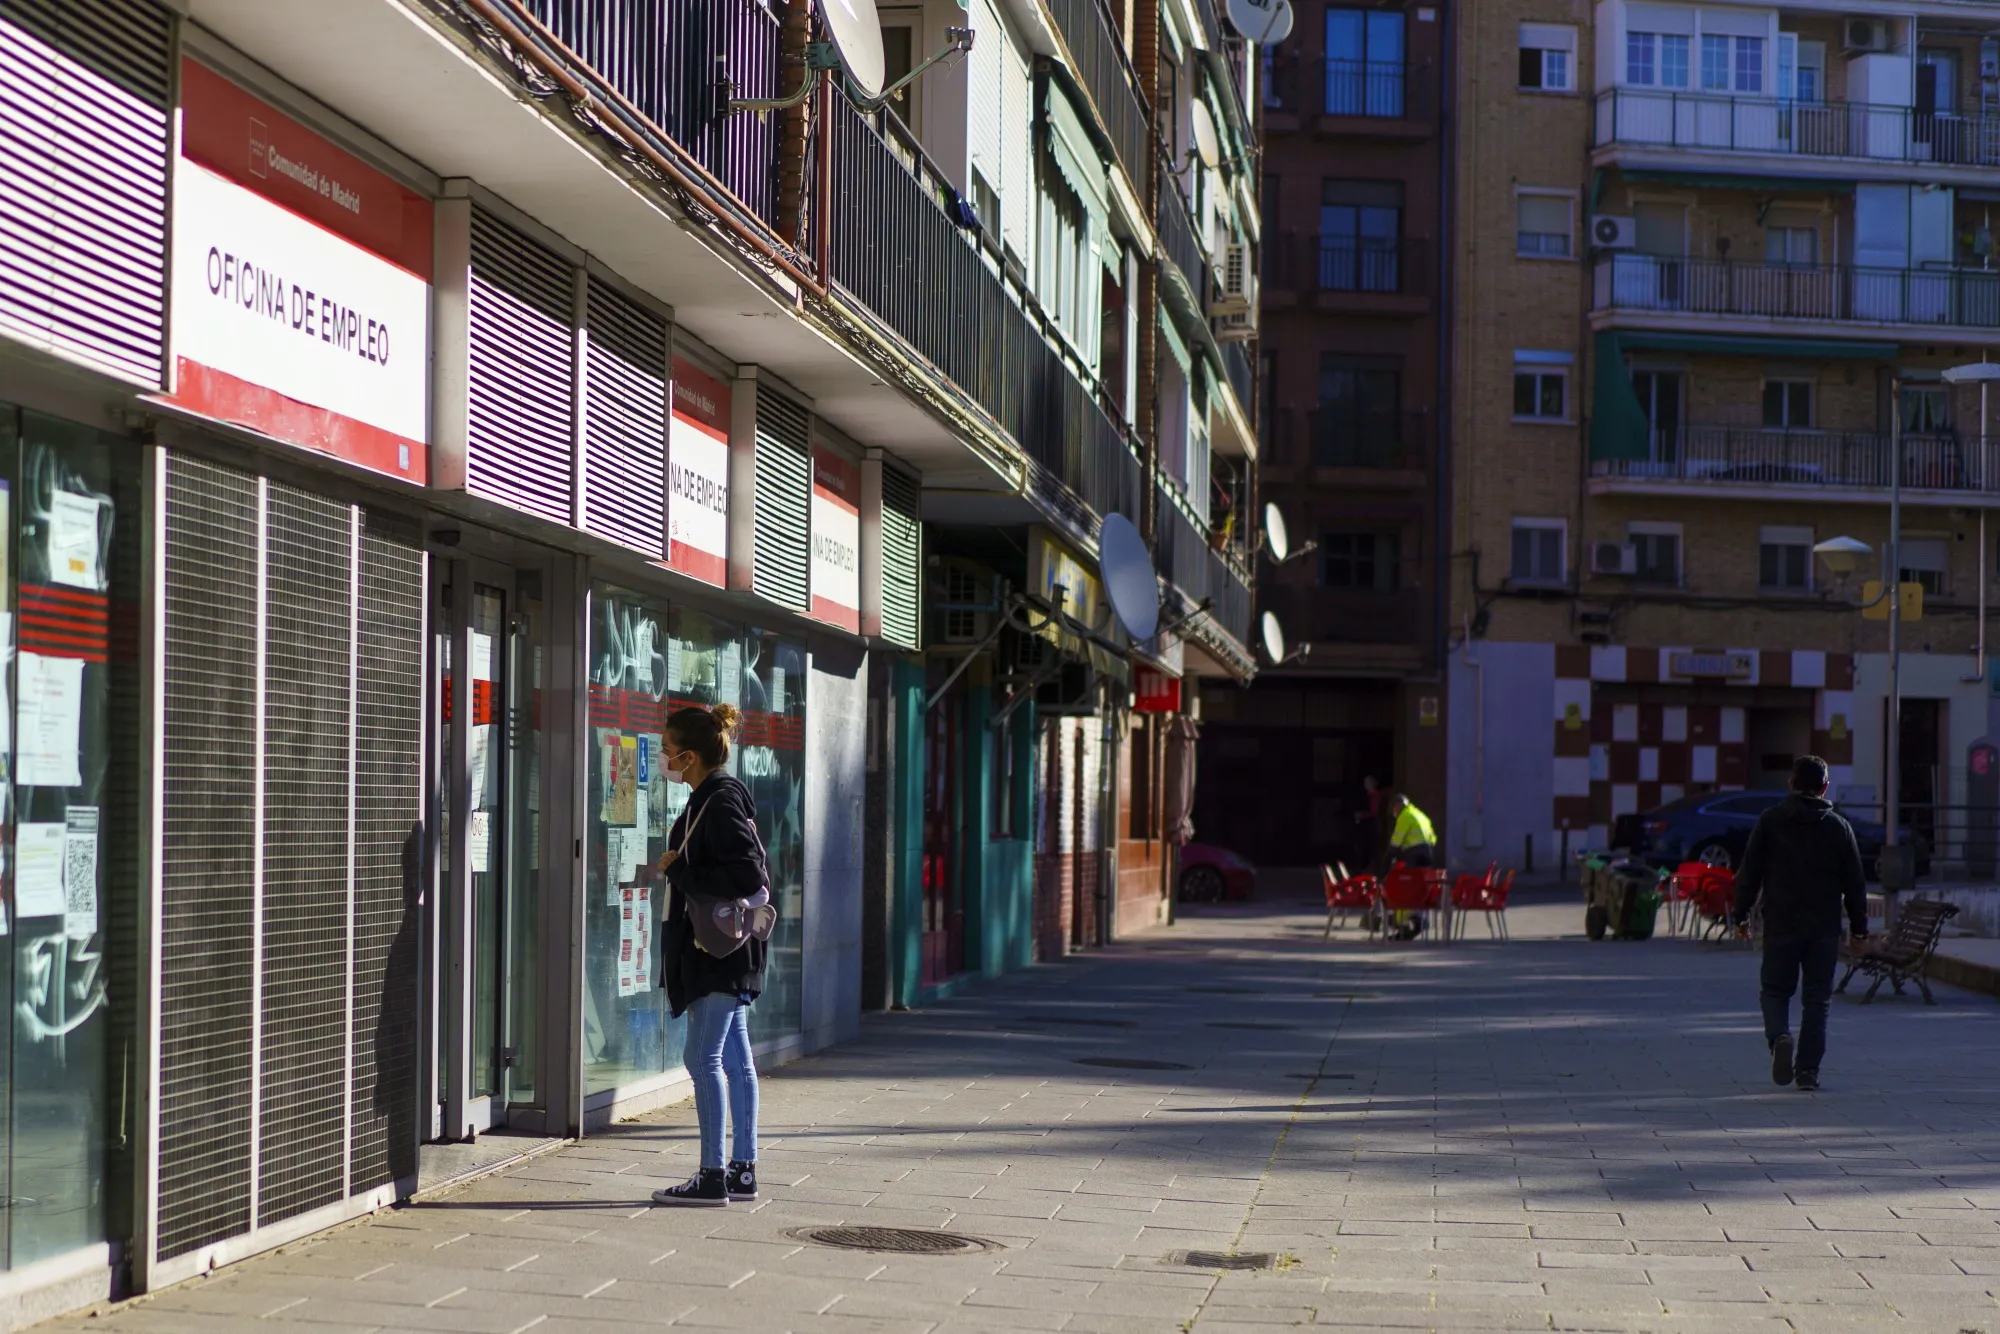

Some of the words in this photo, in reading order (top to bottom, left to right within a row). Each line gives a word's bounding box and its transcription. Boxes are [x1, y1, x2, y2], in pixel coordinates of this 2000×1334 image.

[268, 144, 318, 192] Comunidad
[319, 174, 331, 198] de
[332, 180, 360, 214] Madrid
[207, 246, 286, 324] OFICINA
[292, 284, 315, 336] DE
[321, 297, 389, 367] EMPLEO
[684, 468, 695, 501] DE
[697, 474, 727, 516] EMPLEO
